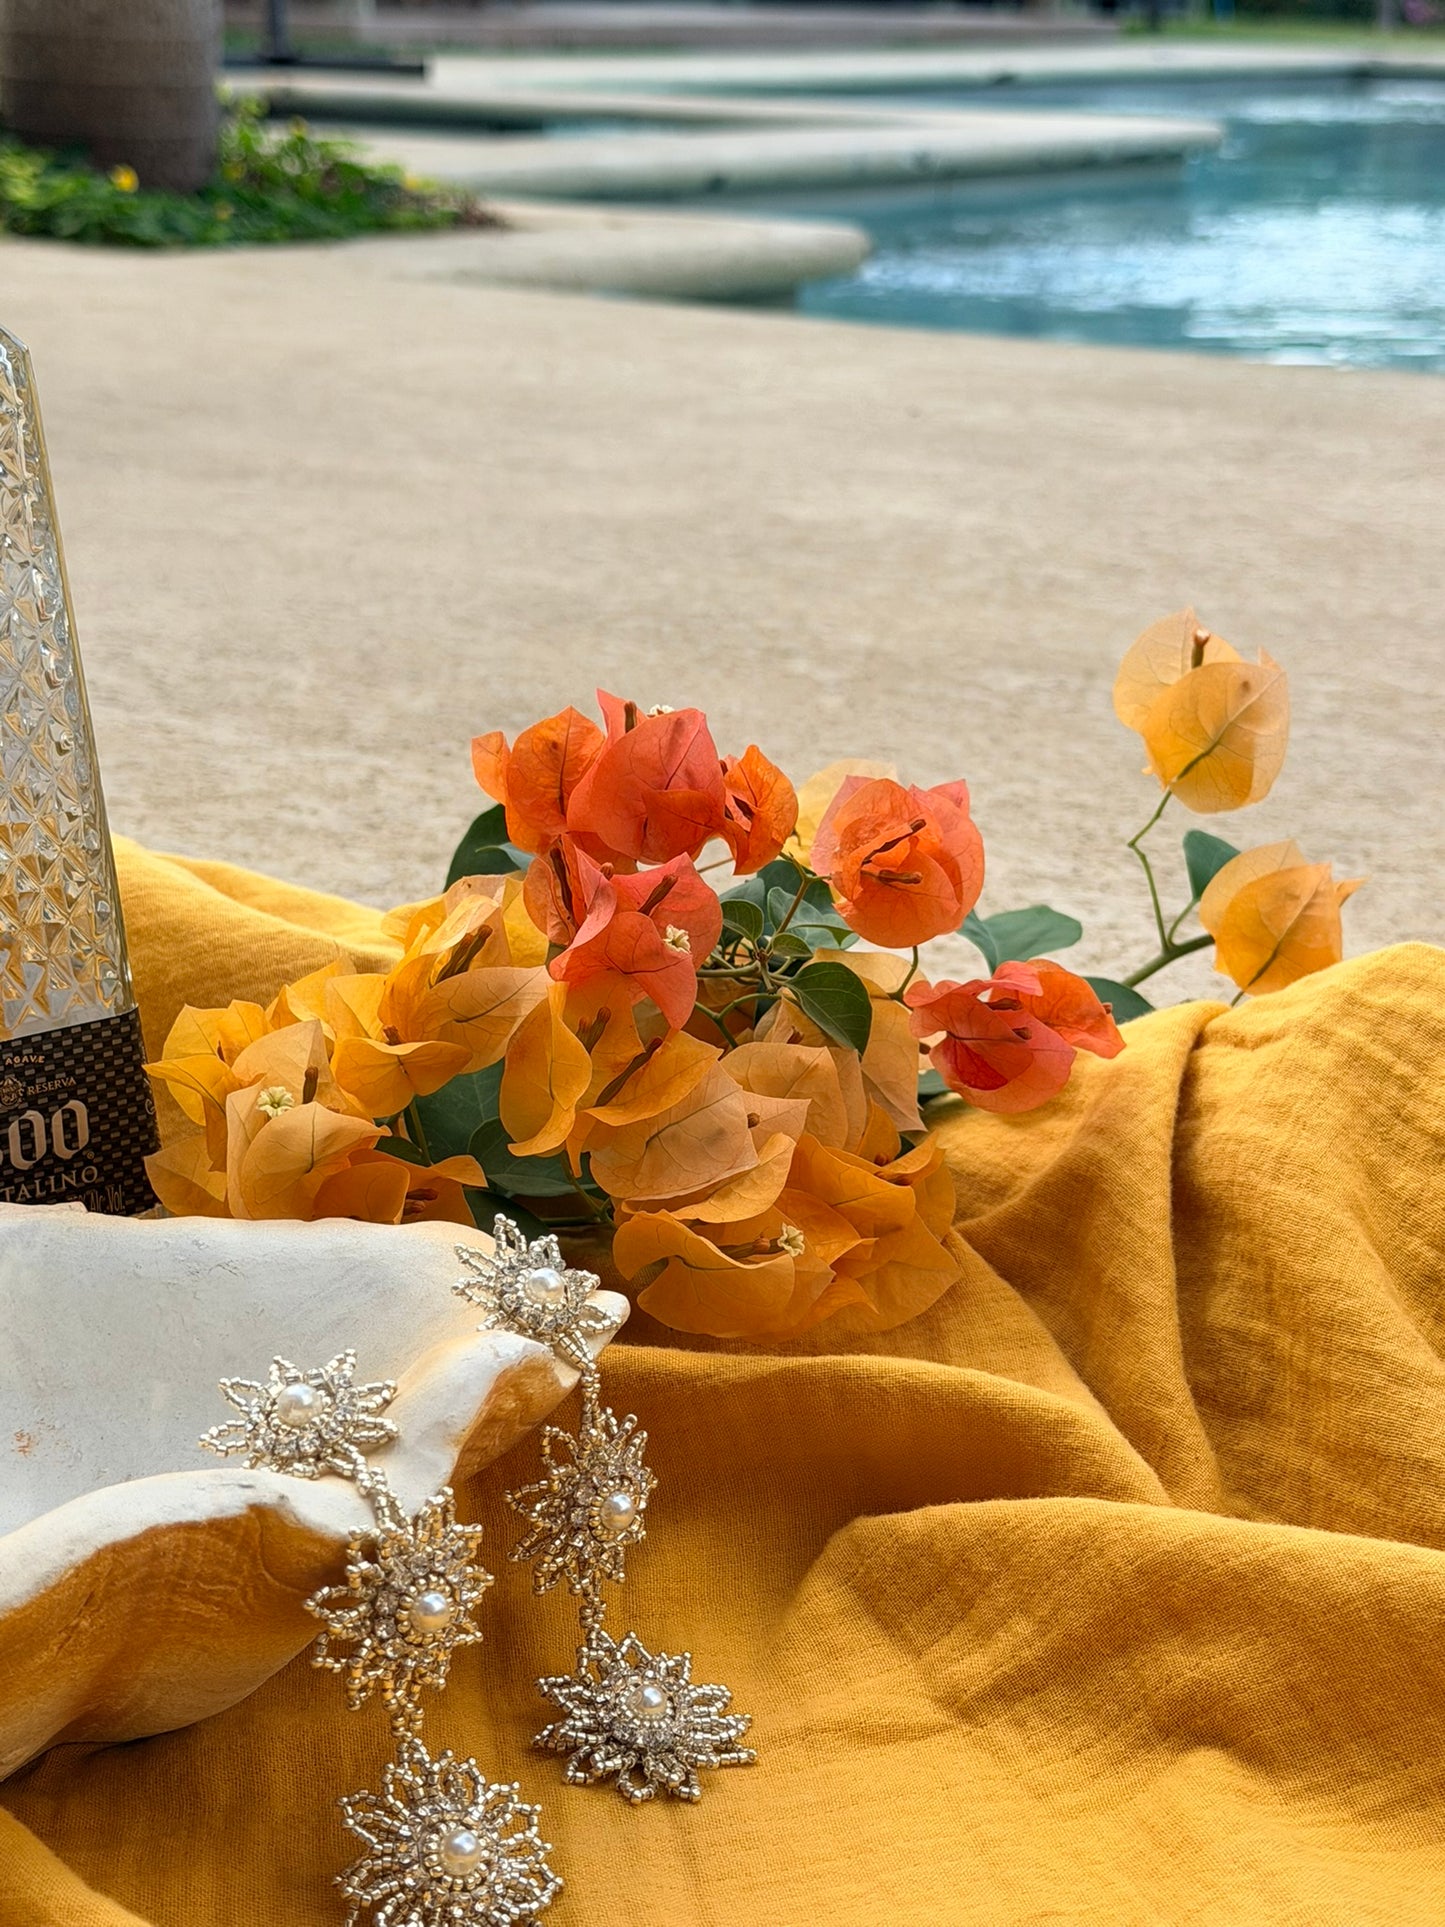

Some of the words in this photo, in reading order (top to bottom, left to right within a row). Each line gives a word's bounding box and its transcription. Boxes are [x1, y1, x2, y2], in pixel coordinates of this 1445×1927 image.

[5, 1054, 45, 1066] AGAVE
[27, 1076, 77, 1096] RESERVA
[0, 1099, 89, 1171] 00
